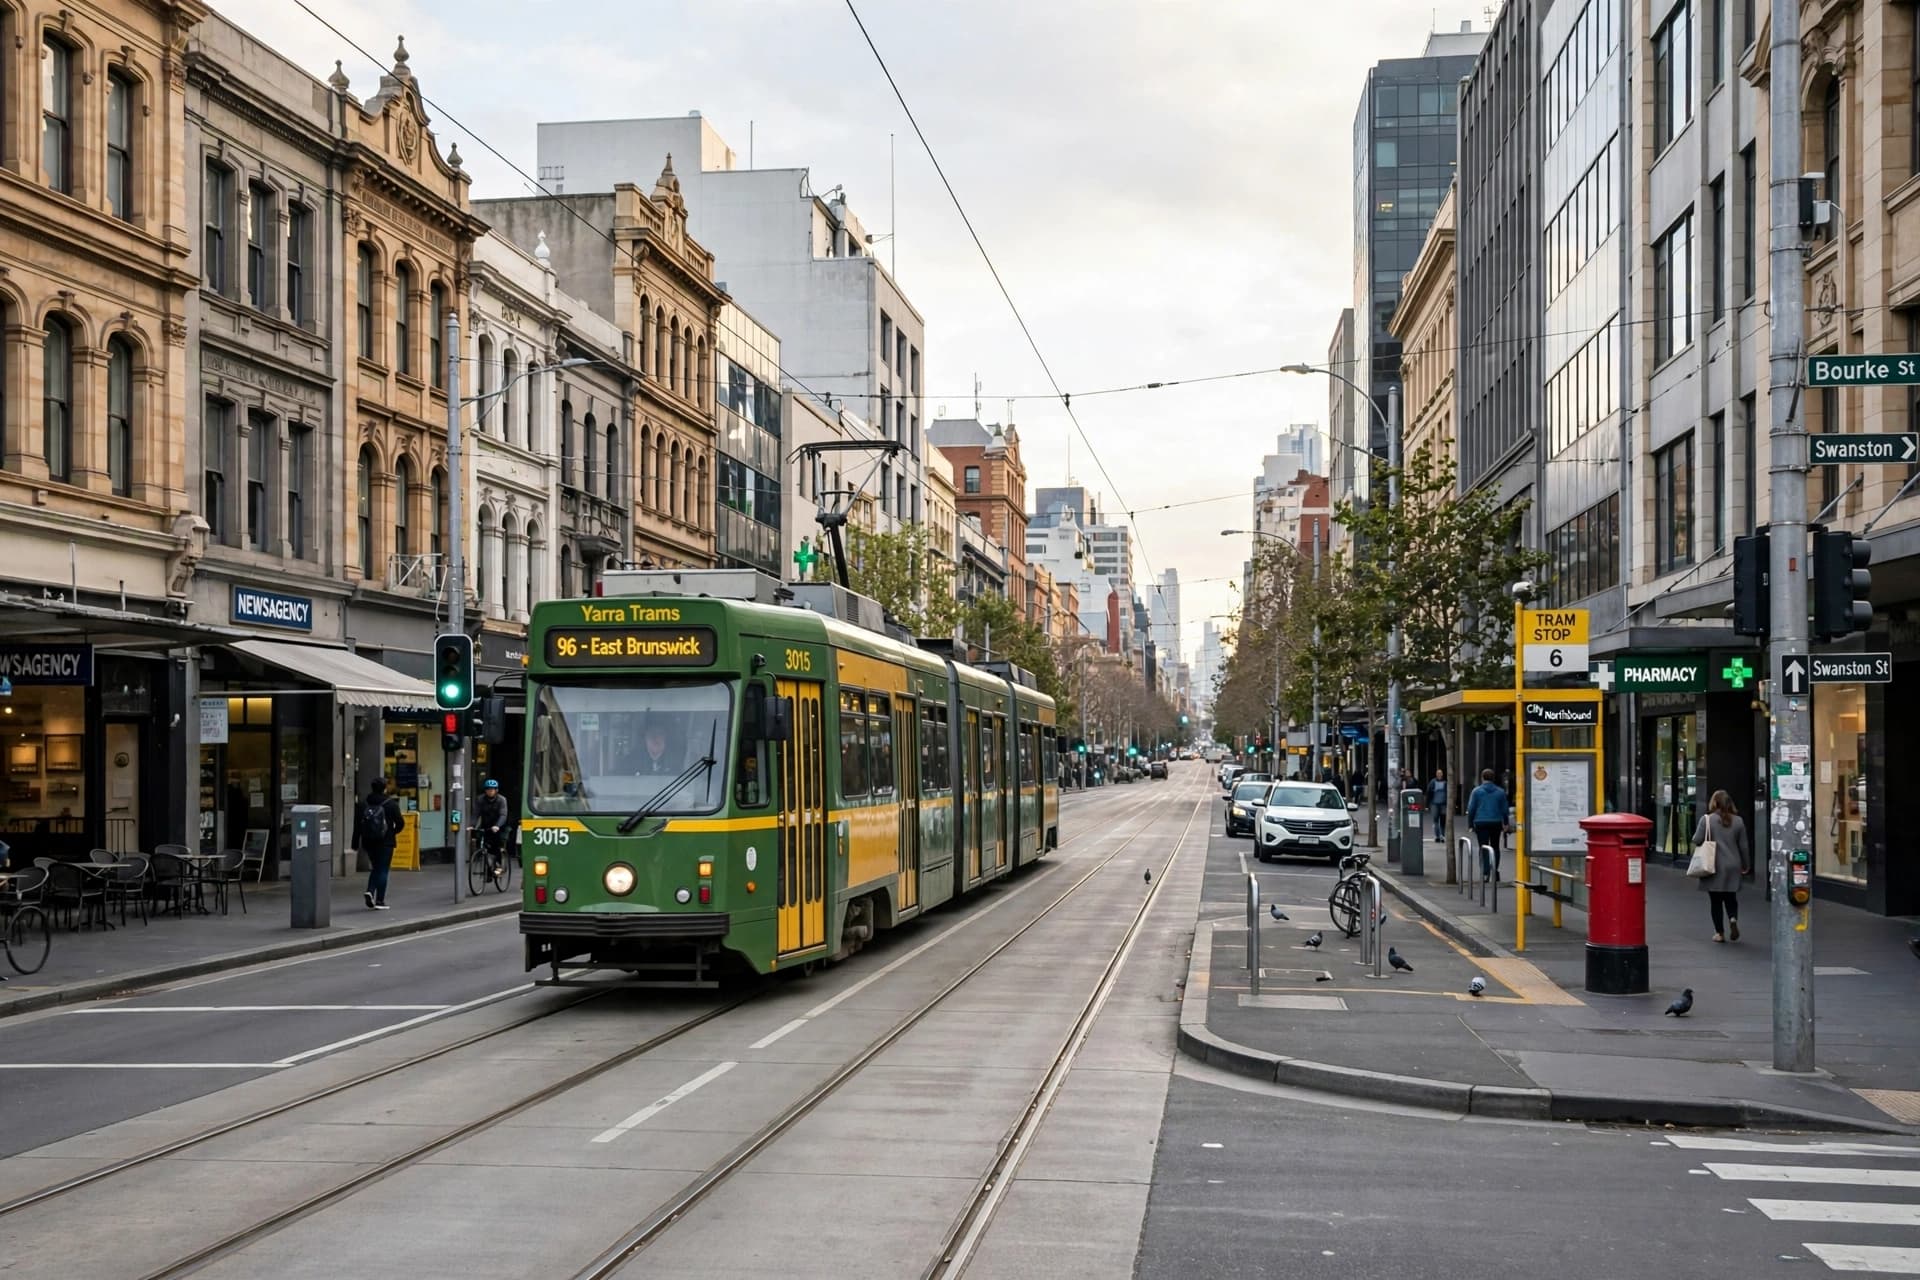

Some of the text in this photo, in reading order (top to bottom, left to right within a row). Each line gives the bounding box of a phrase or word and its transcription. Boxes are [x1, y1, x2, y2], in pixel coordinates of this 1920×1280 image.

[1815, 360, 1916, 380] Bourke St
[1815, 440, 1893, 458] Swanston
[238, 593, 309, 623] NEWSAGENCY
[581, 604, 681, 622] Yarra Trams
[1536, 613, 1576, 627] TRAM
[1534, 628, 1571, 641] STOP
[557, 637, 577, 656] 96
[591, 637, 623, 655] East
[627, 635, 701, 656] Brunswick
[785, 648, 811, 671] 3015
[1549, 649, 1563, 667] 6
[1624, 667, 1697, 682] PHARMACY
[1813, 659, 1889, 676] Swanston St
[533, 828, 570, 845] 3015
